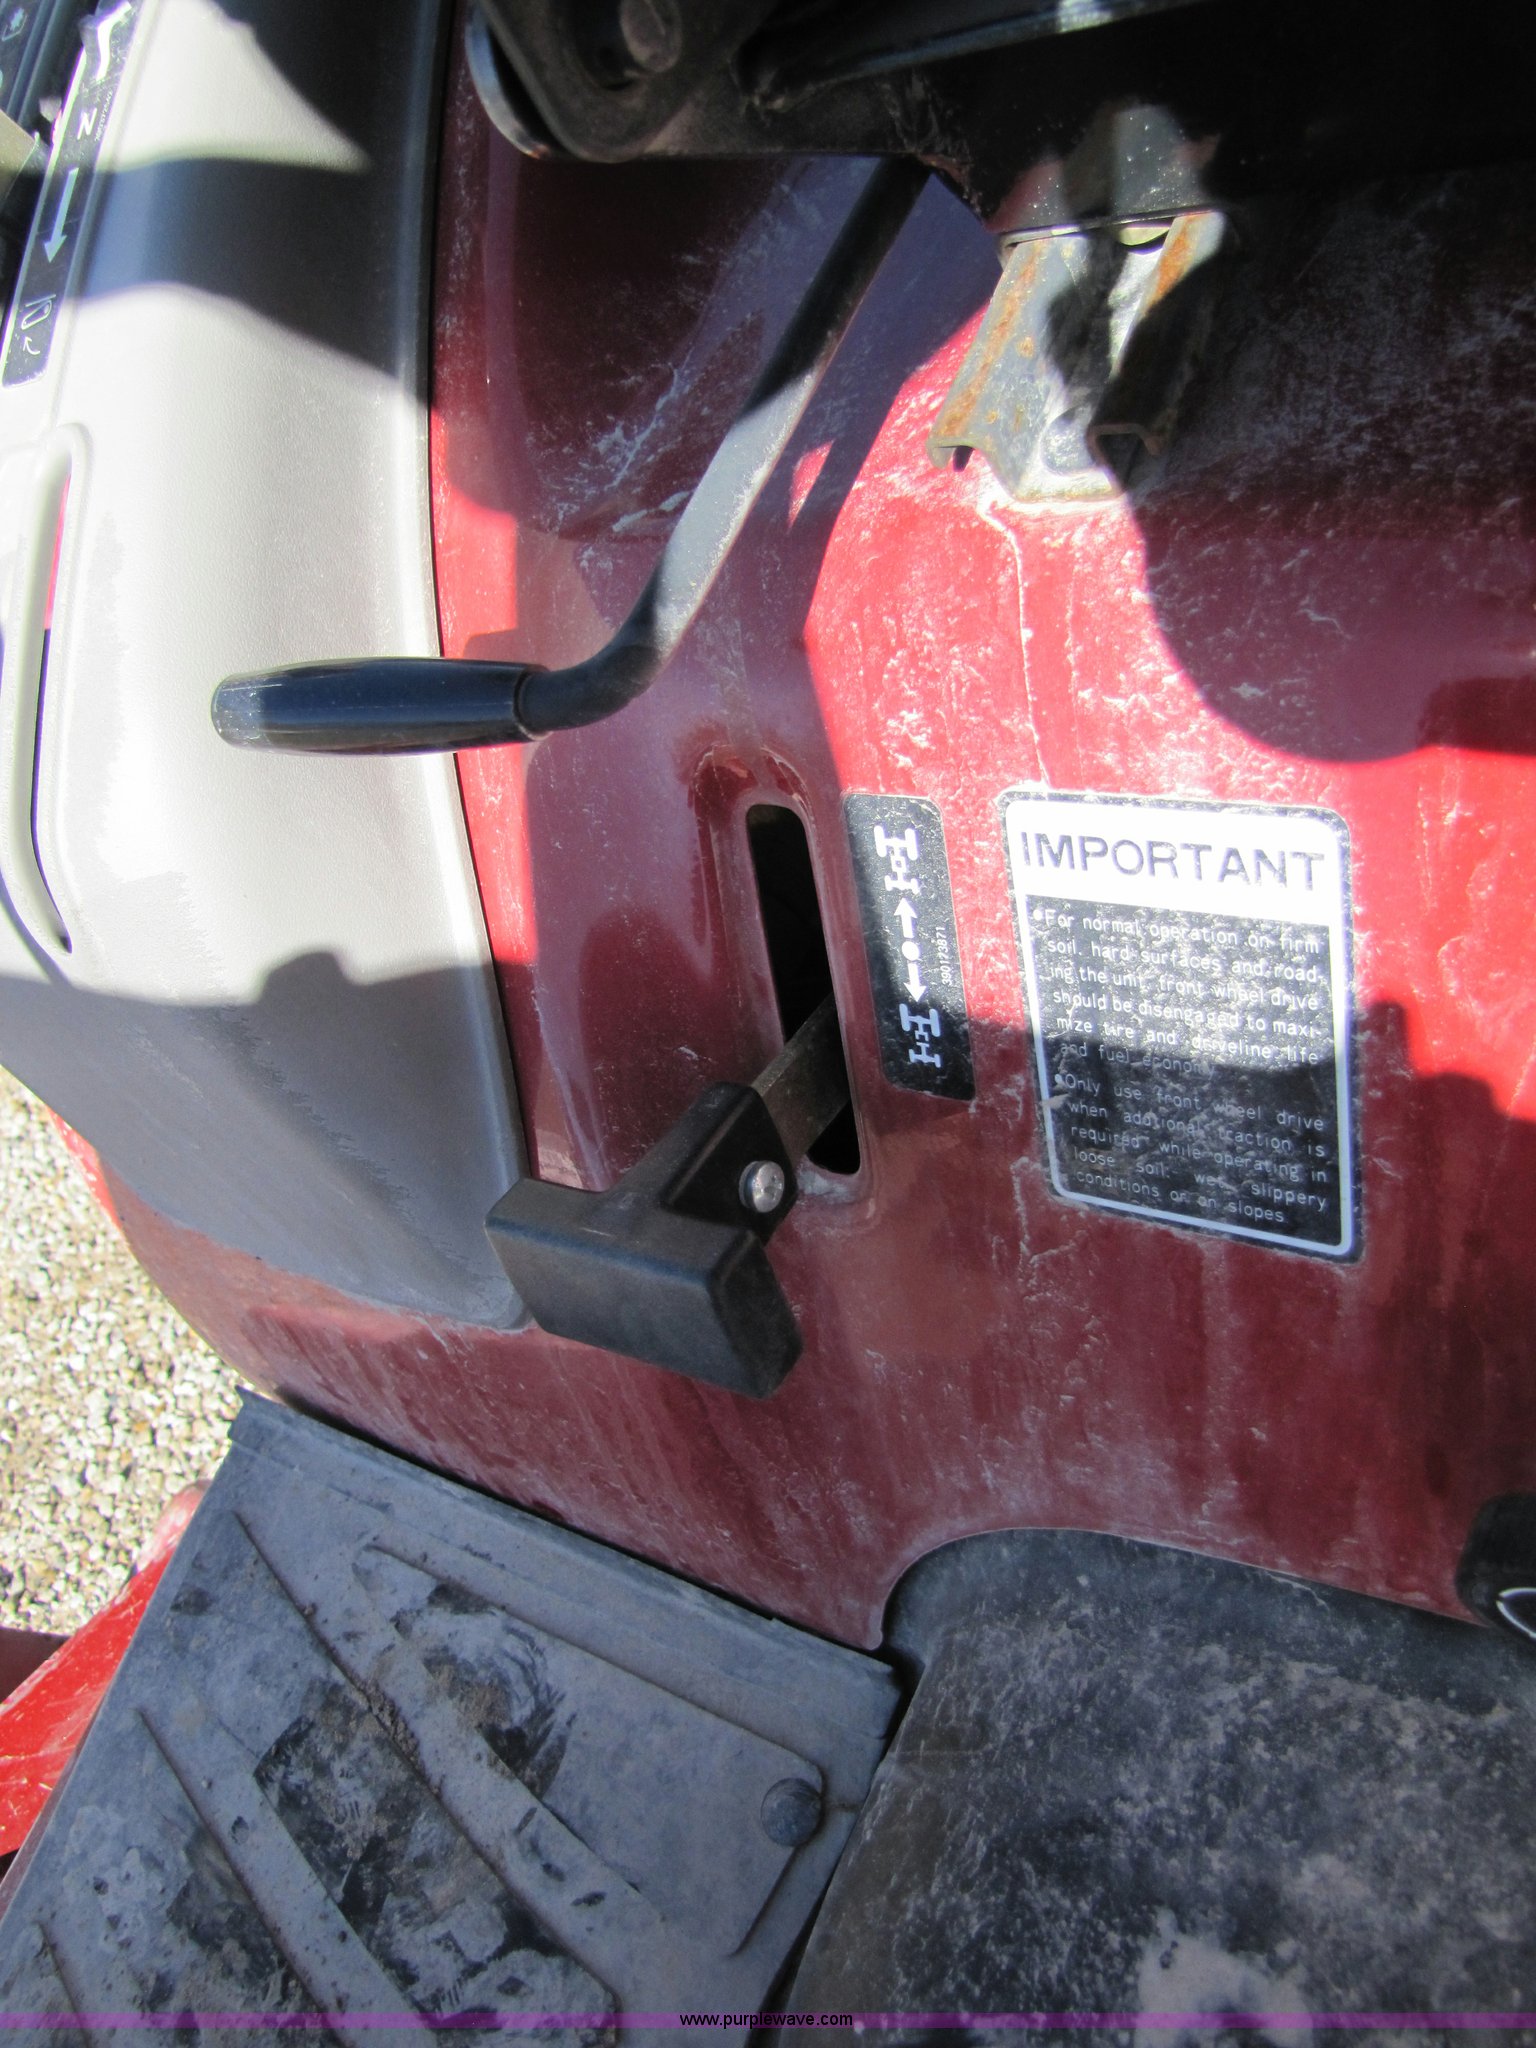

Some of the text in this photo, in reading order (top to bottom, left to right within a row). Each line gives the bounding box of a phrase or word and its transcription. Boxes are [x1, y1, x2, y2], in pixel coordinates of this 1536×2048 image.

[1020, 831, 1326, 891] IMPORTANT
[1044, 909, 1320, 953] For normal operation on firm
[1091, 941, 1130, 961] hard
[1141, 950, 1222, 972] surfaces
[1232, 958, 1264, 976] and
[1050, 967, 1075, 984] ing
[1079, 966, 1108, 983] the
[1159, 974, 1202, 994] front
[1213, 983, 1265, 1003] wheel
[1271, 990, 1319, 1010] drive
[1053, 989, 1107, 1010] should
[1112, 995, 1132, 1012] be
[1138, 1000, 1239, 1029] disengaged
[1247, 1014, 1266, 1031] to
[1056, 1016, 1318, 1064] mize tire and driveline life
[1060, 1042, 1088, 1057] and
[1098, 1045, 1130, 1063] fuel
[1065, 1074, 1101, 1097] Only
[1113, 1085, 1142, 1100] use
[1157, 1089, 1202, 1110] front
[1276, 1109, 1324, 1131] drive
[1068, 1101, 1108, 1118] when
[1219, 1126, 1291, 1151] traction
[1307, 1139, 1325, 1157] is
[1071, 1125, 1328, 1183] required while operating in
[1074, 1147, 1116, 1167] loose
[1251, 1183, 1327, 1212] slippery
[1076, 1170, 1160, 1198] conditions
[1170, 1190, 1187, 1202] or
